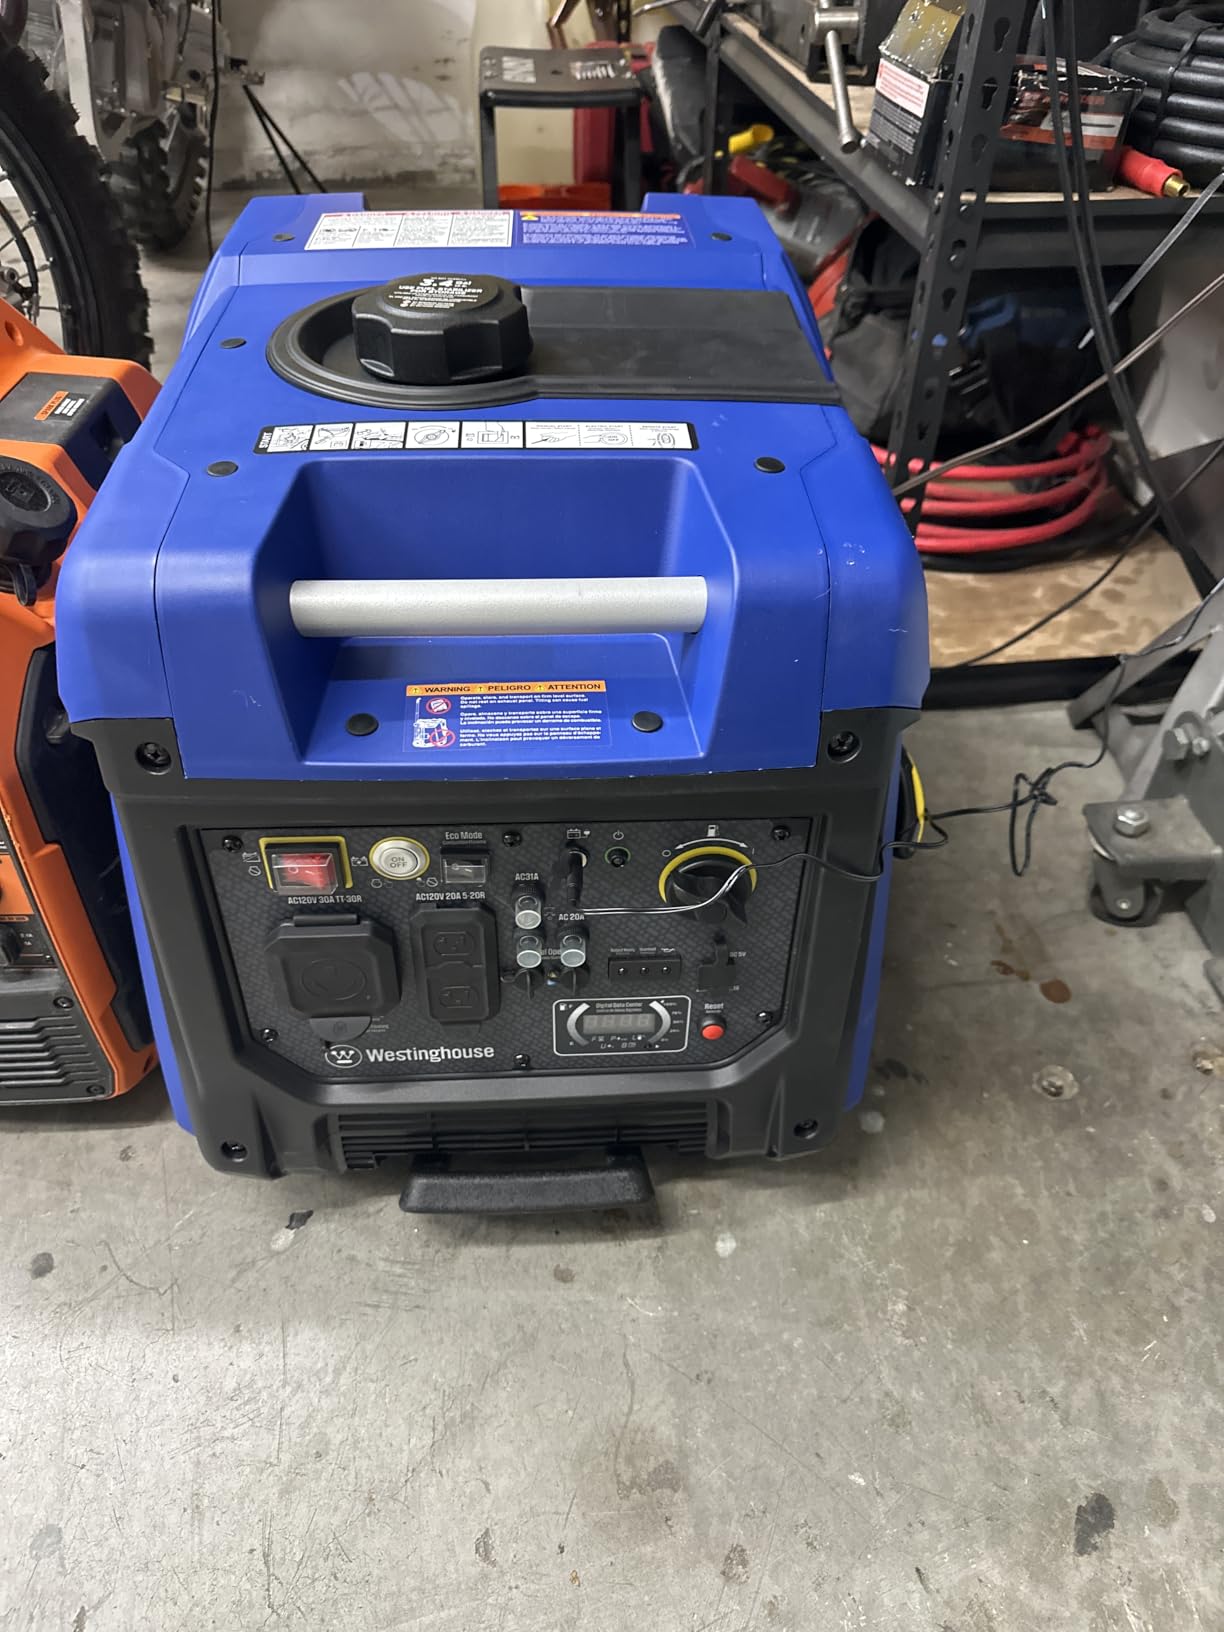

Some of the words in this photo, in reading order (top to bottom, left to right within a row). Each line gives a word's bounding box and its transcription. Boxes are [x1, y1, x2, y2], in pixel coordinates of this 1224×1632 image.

[420, 279, 453, 287] 3.4
[445, 832, 459, 840] Eco
[515, 873, 539, 881] AC31A
[320, 896, 334, 904] 30A
[336, 895, 362, 903] TT-30R
[416, 893, 444, 901] AC120V
[462, 891, 485, 899] 5-20R
[365, 1047, 494, 1062] Westinghouse
